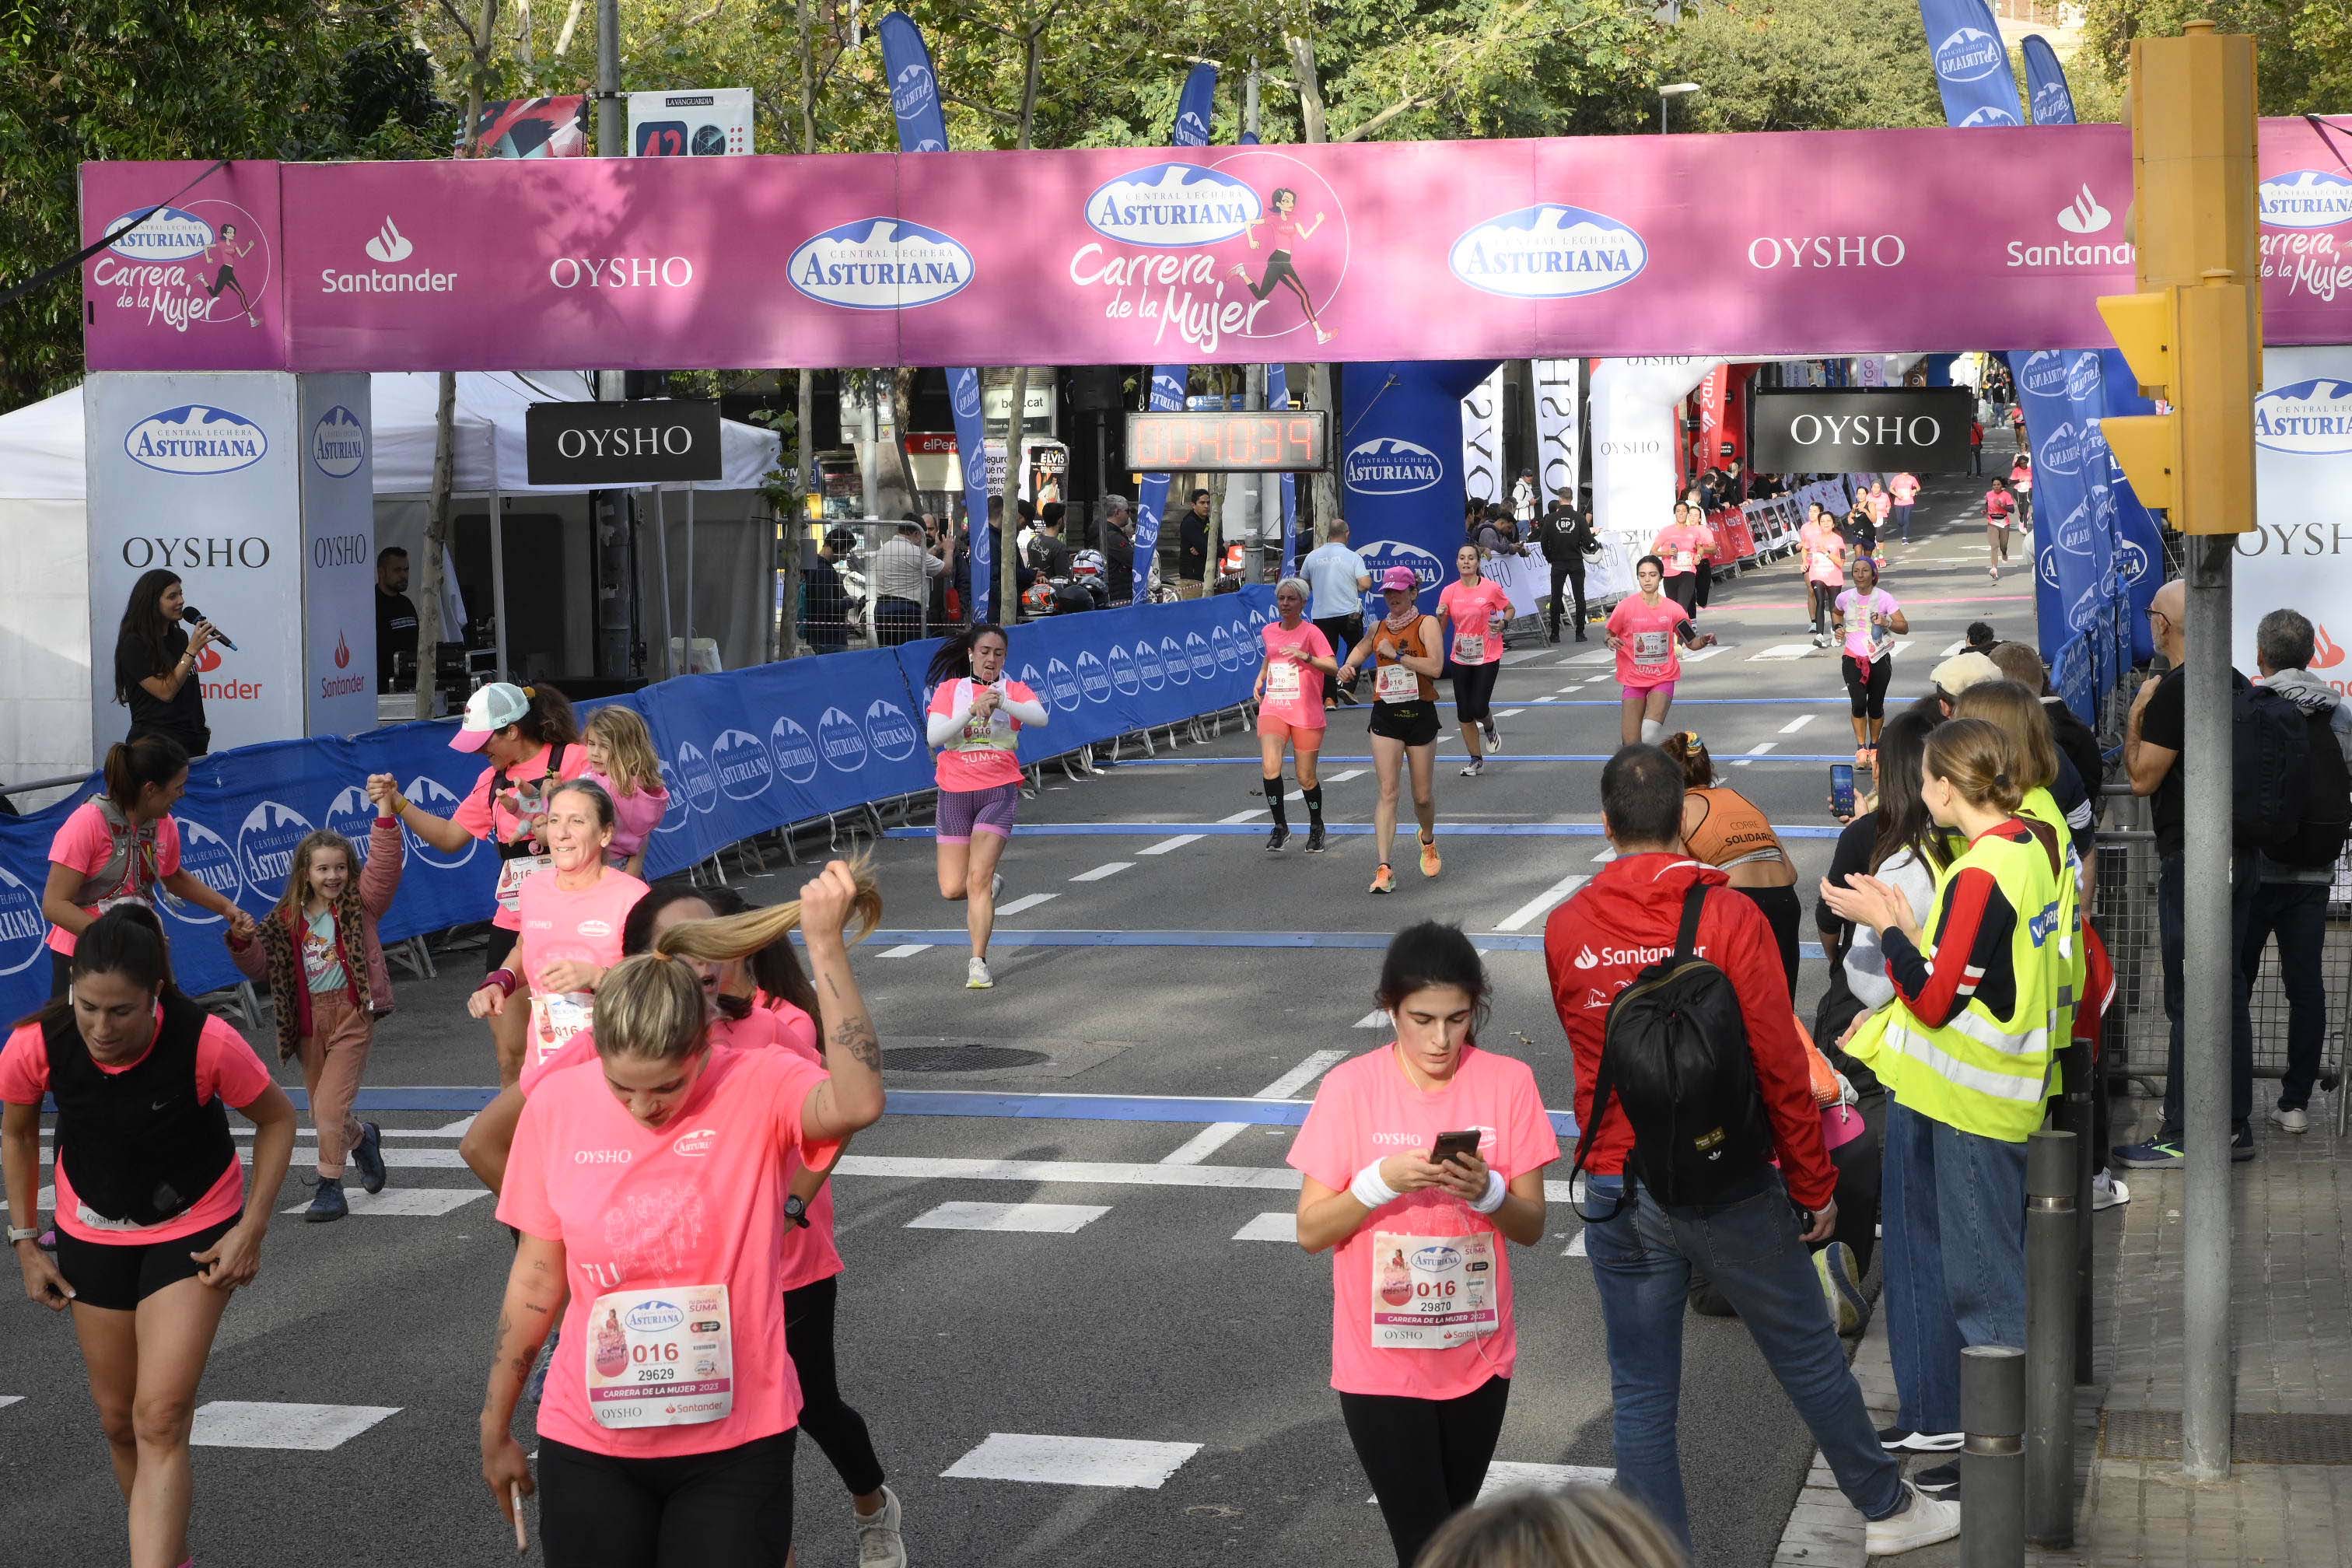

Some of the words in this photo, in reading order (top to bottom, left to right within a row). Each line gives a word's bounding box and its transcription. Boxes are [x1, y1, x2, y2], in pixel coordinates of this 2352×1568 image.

[1125, 192, 1181, 201] CENTRAL
[1098, 194, 1248, 226] ASTURIANA
[829, 249, 891, 259] CENTRAL
[894, 248, 954, 258] LECHERA
[1748, 235, 1906, 269] OYSHO
[2007, 240, 2136, 266] Santand
[2259, 233, 2334, 256] arrera
[801, 253, 960, 285] ASTURIANA
[1069, 243, 1215, 286] Carrera
[1464, 240, 1633, 275] ASTURIANA
[93, 257, 188, 288] Carrera
[321, 268, 457, 292] Santander
[549, 256, 693, 288] OYSHO
[2278, 256, 2292, 277] la
[2289, 251, 2352, 302] Muje
[117, 289, 133, 308] de
[137, 288, 150, 308] la
[148, 285, 220, 332] Mujer
[1105, 289, 1132, 318] de
[1138, 286, 1157, 318] la
[1153, 281, 1269, 353] Mujer
[1538, 359, 1573, 496] OYSH
[1790, 415, 1941, 446] OYSHO
[2256, 408, 2352, 436] ASTURI
[135, 431, 257, 457] ASTURIANA
[317, 433, 362, 460] ASTURIANA
[558, 425, 693, 459] OYSHO
[923, 438, 958, 450] elPeri
[1464, 378, 1494, 502] OYS
[1601, 440, 1660, 456] OYSHO
[1041, 453, 1065, 464] ELVIS
[1347, 460, 1436, 483] ASTURIANA
[314, 534, 366, 569] OYSHO
[2234, 523, 2352, 557] OYSH
[122, 537, 270, 568] OYSHO
[201, 678, 263, 699] ander
[321, 673, 365, 699] Santander
[776, 744, 815, 768] ASTURIANA
[822, 733, 865, 758] ASTURIANA
[961, 752, 1000, 763] SUMA
[715, 756, 772, 786] ASTURIANA
[437, 803, 459, 815] LECHER
[341, 821, 368, 832] CENTRAL
[1730, 821, 1759, 831] CORRE
[254, 837, 282, 850] CENTRAL
[1601, 945, 1706, 966] Santanr
[1372, 1132, 1422, 1146] OYSHO
[574, 1149, 632, 1165] OYSHO
[1415, 1254, 1458, 1266] ASTURIANA
[580, 1262, 621, 1288] TU
[1416, 1280, 1456, 1297] 016
[689, 1304, 717, 1313] SUMA
[1420, 1301, 1451, 1312] 29870
[630, 1313, 679, 1325] ASTURIANA
[1384, 1331, 1423, 1339] OYSHO
[632, 1342, 679, 1363] 016
[638, 1368, 674, 1381] 29629
[603, 1389, 641, 1398] CARRERA
[699, 1383, 719, 1391] 2023
[602, 1407, 642, 1419] OYSHO
[677, 1402, 723, 1413] Santander
